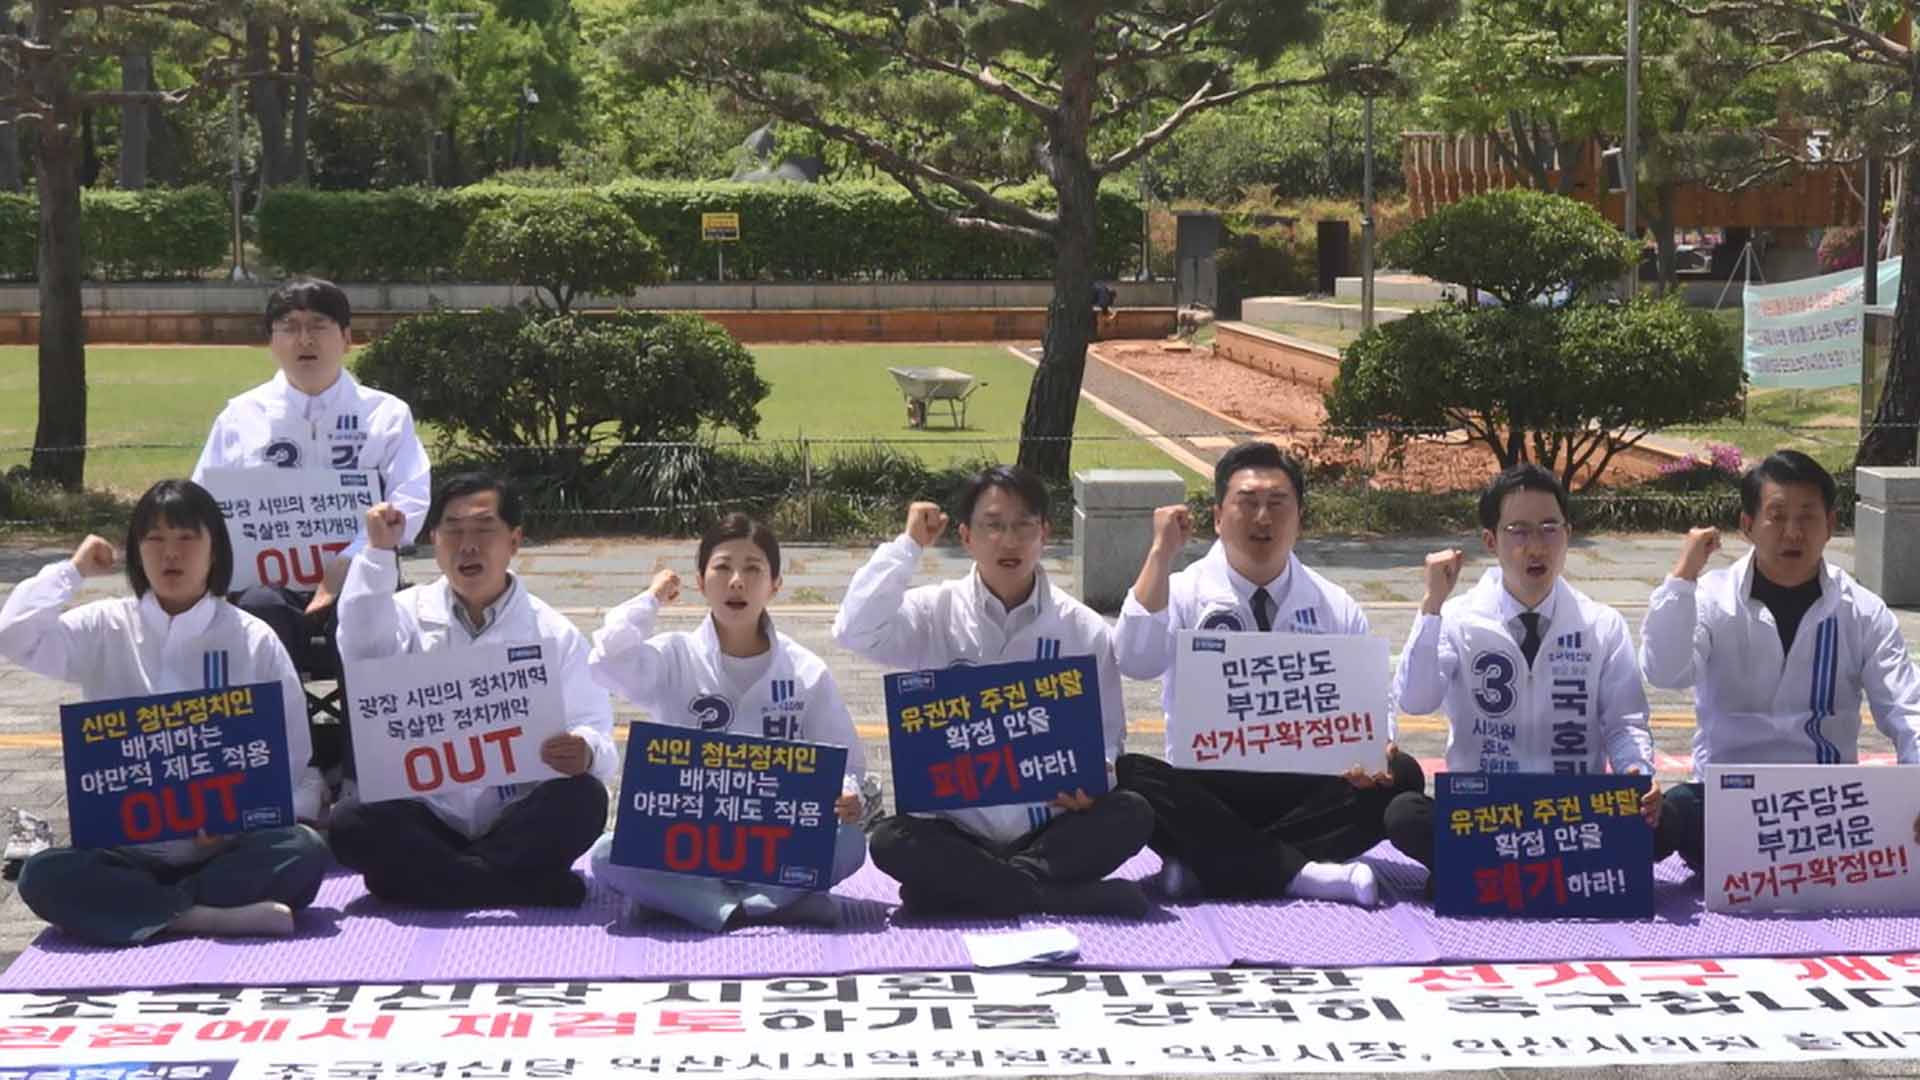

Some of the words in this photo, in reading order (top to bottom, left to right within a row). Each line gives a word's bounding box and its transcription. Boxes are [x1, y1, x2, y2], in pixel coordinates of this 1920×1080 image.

[259, 496, 304, 516] 시민의
[310, 490, 373, 512] 정치개혁
[296, 516, 358, 538] 정치개악
[359, 694, 399, 719] 광장
[407, 680, 463, 707] 시민의
[469, 664, 548, 698] 정치개혁
[1222, 649, 1336, 689] 민주당도
[1473, 651, 1516, 716] 3
[82, 709, 128, 743] 신인
[137, 688, 255, 734] 청년정치인
[387, 715, 445, 740] 묵살한
[454, 697, 530, 730] 정치개악
[901, 696, 971, 733] 유권자
[980, 681, 1029, 715] 주권
[1034, 668, 1084, 700] 박탈
[1227, 682, 1341, 722] 부끄러운
[121, 725, 223, 761] 배제하는
[946, 718, 996, 750] 확정
[1003, 705, 1050, 740] 안을
[1192, 712, 1374, 762] 선거구확정안!
[81, 764, 153, 795] 야만적
[162, 753, 215, 782] 제도
[222, 740, 271, 770] 적용
[404, 726, 523, 792] OUT
[647, 739, 691, 765] 신인
[702, 741, 817, 774] 청년정치인
[680, 769, 780, 798] 배제하는
[1752, 782, 1869, 827] 민주당도
[121, 772, 246, 842] OUT
[634, 792, 704, 818] 야만적
[714, 796, 763, 823] 제도
[774, 799, 822, 827] 적용
[1450, 803, 1523, 836] 유권자
[1533, 795, 1583, 825] 주권
[1591, 788, 1641, 817] 박탈
[664, 821, 792, 876] OUT
[1496, 829, 1545, 859] 확정
[1555, 822, 1602, 852] 안을
[1758, 815, 1874, 862] 부끄러운
[1723, 845, 1909, 905] 선거구확정안!
[642, 974, 979, 1003] 시의원
[1409, 960, 1739, 992] 선거구
[441, 1003, 1061, 1039] 재검토하기를
[1102, 997, 1405, 1028] 강력히
